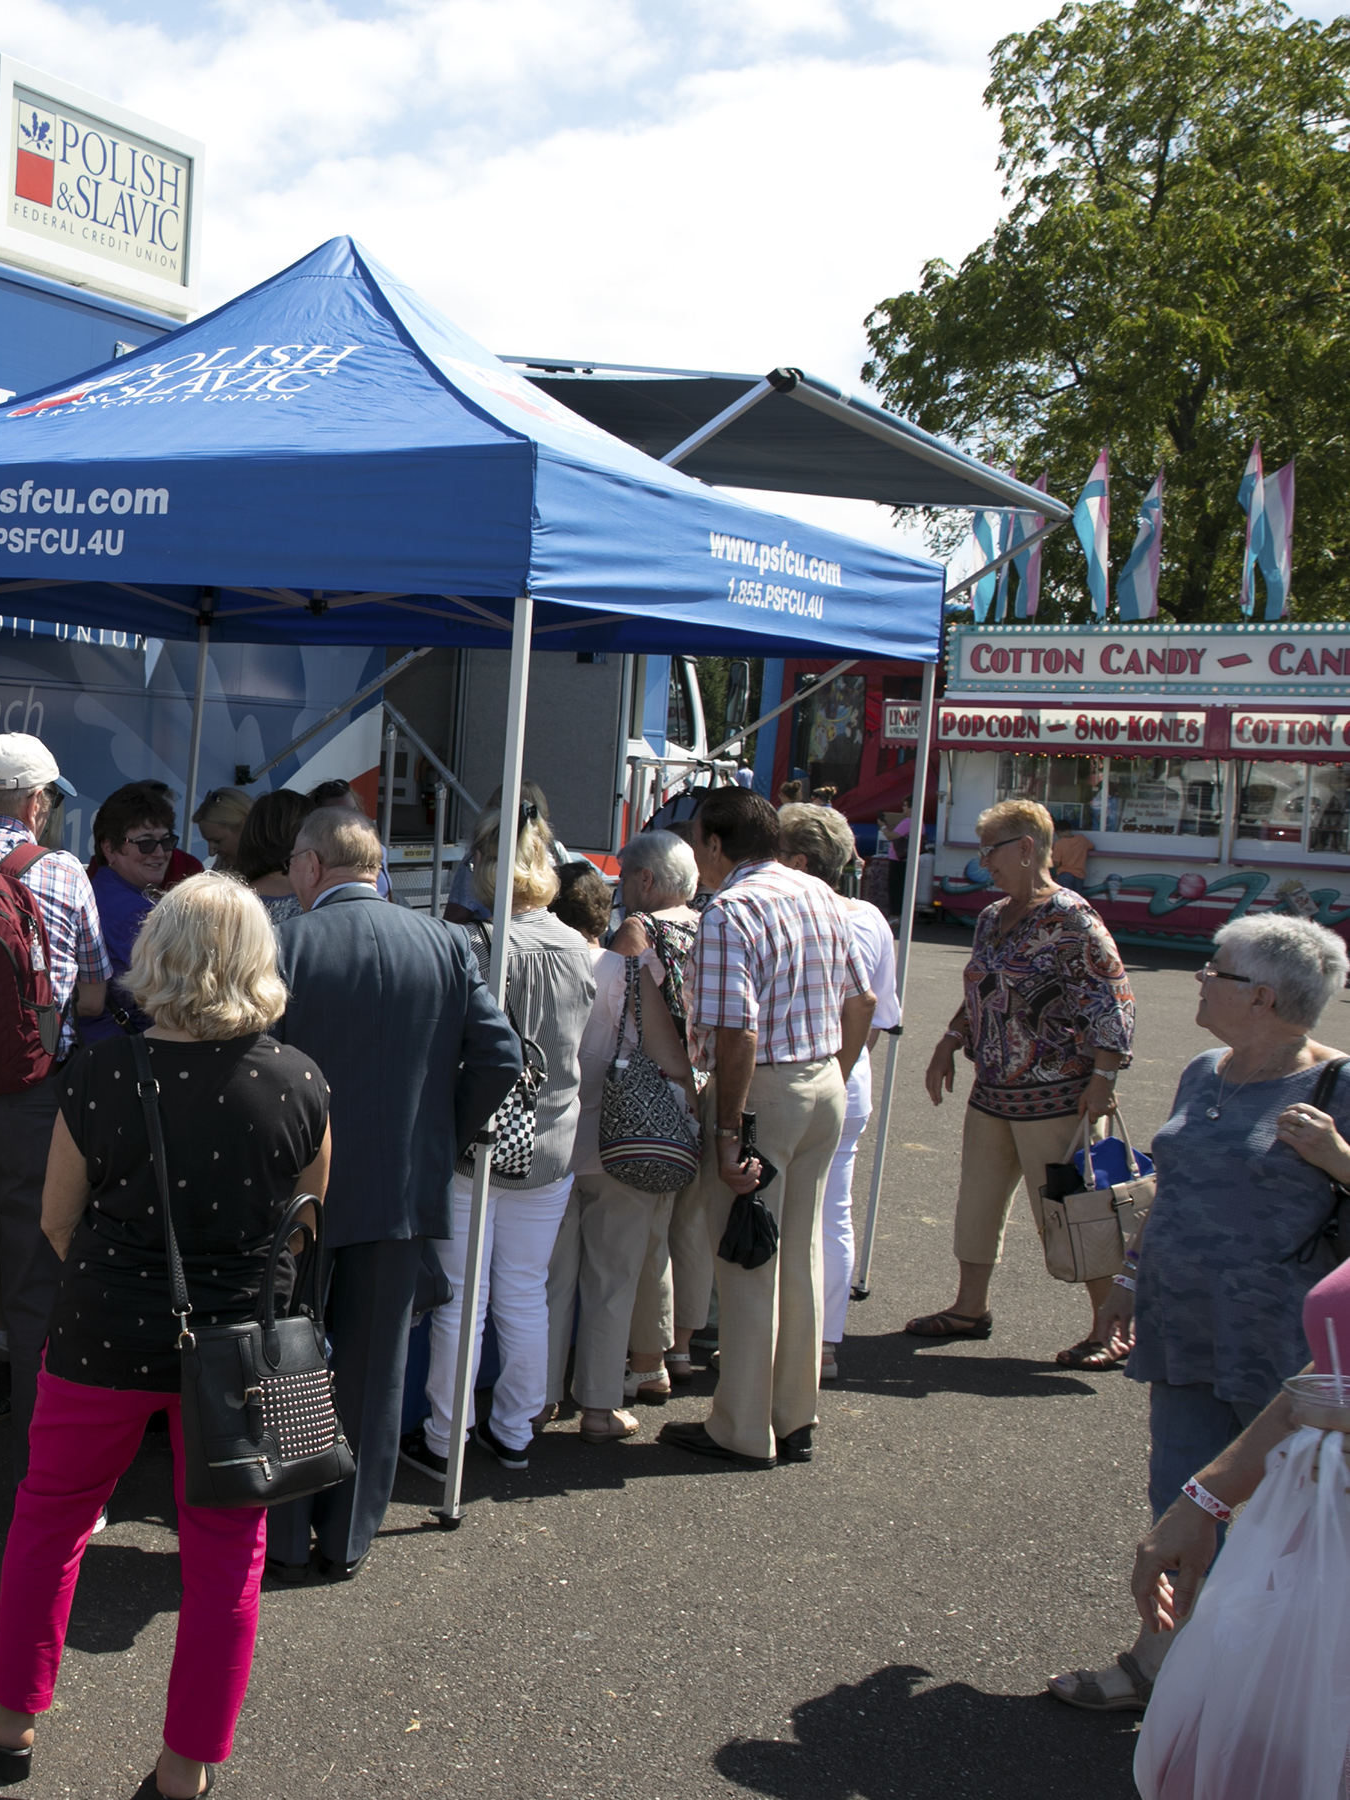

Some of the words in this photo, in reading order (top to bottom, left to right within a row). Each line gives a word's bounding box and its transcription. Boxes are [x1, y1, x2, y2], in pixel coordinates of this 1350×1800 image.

[58, 118, 182, 209] POLISH
[13, 202, 76, 235] FEDERAL
[81, 226, 130, 254] CREDIT
[135, 245, 178, 271] UNION
[202, 393, 296, 402] UNION
[709, 530, 843, 587] www.psfcu.com
[726, 576, 825, 620] 1.855.PSFCU.4U
[54, 620, 149, 652] UNION
[969, 643, 1085, 675] COTTON
[1100, 643, 1208, 676] CANDY
[941, 711, 1041, 740] POPCORN
[1074, 713, 1200, 744] SNO-KONES
[1235, 715, 1334, 747] COTTON
